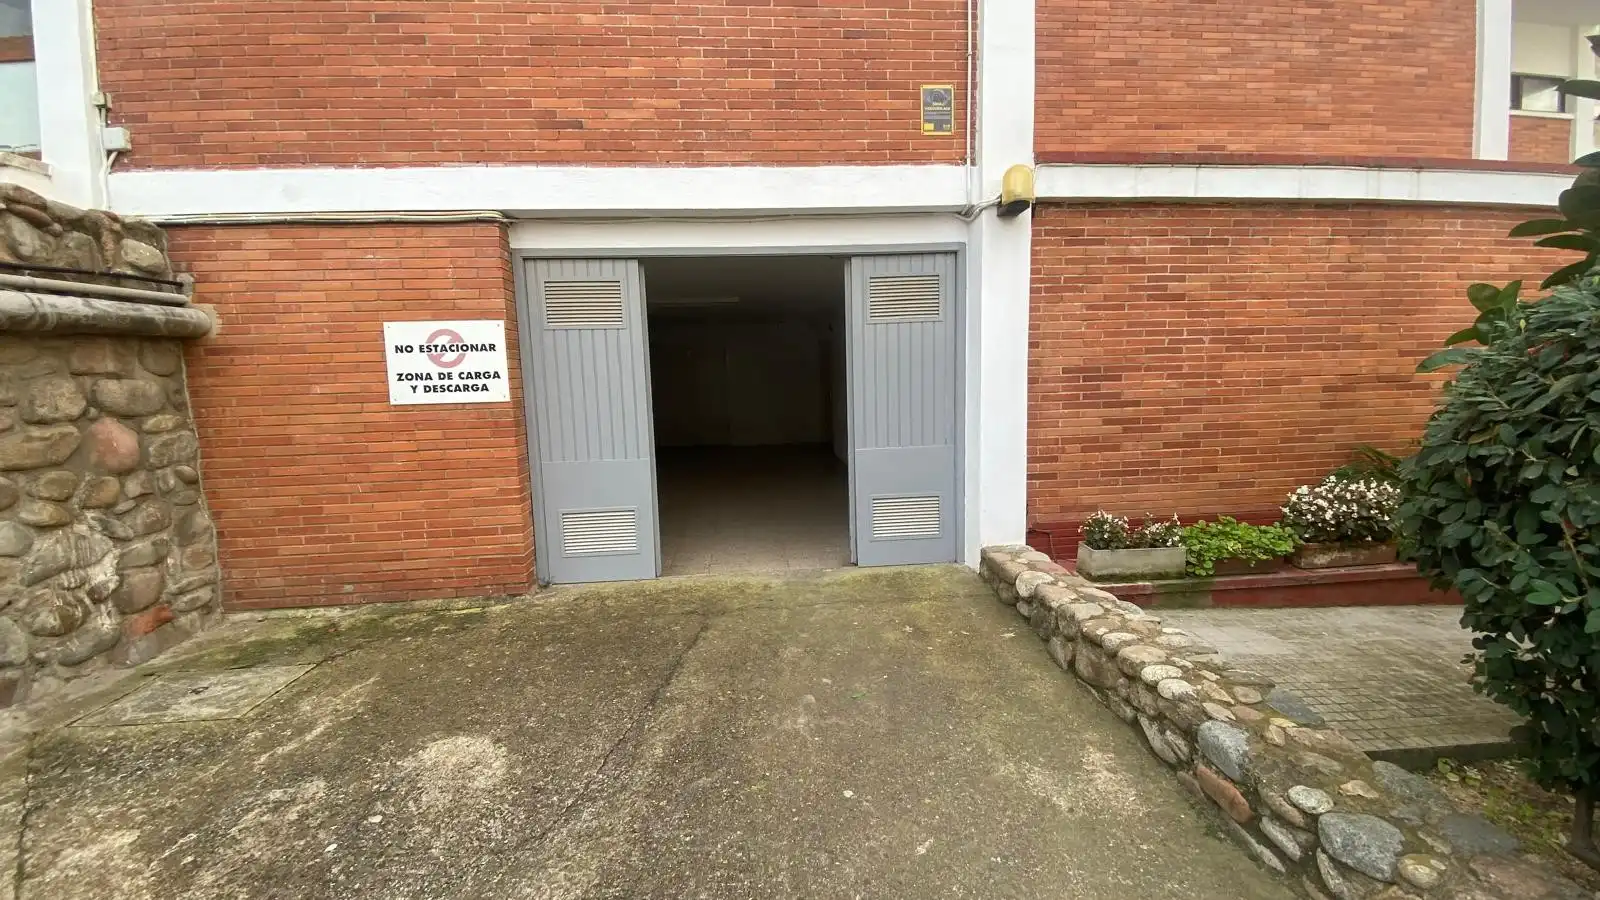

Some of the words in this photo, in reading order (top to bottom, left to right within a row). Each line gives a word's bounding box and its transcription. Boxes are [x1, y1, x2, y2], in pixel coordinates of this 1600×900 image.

[394, 345, 414, 354] NO
[419, 343, 497, 353] ESTACIONAR
[396, 372, 433, 381] ZONA
[437, 372, 454, 381] DE
[458, 371, 501, 380] CARGA
[410, 385, 418, 394] Y
[423, 383, 490, 393] DESCARGA
